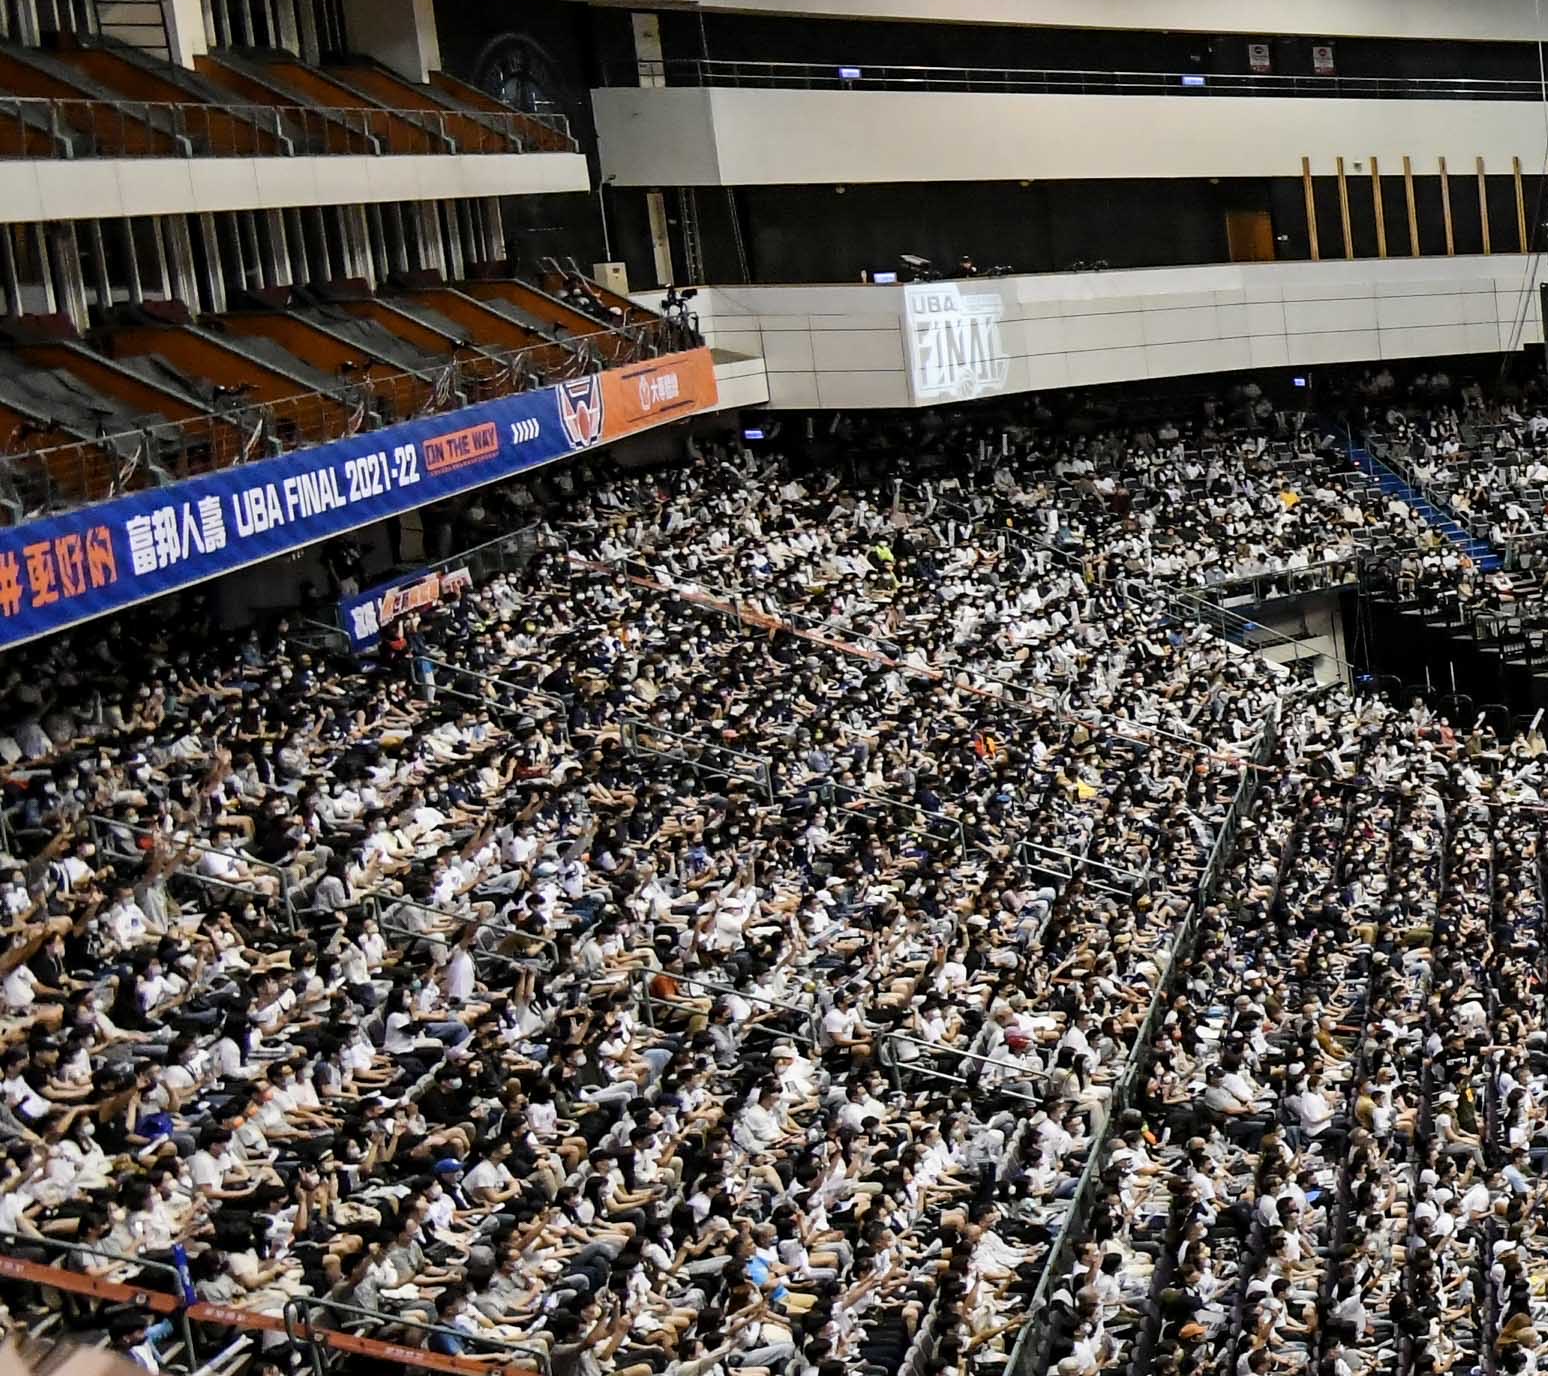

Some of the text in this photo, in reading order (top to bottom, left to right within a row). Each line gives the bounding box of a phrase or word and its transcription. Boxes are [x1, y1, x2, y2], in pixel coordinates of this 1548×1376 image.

[126, 495, 227, 576] 富邦人壽
[233, 482, 285, 539] UBA
[283, 466, 347, 521] FINAL
[344, 444, 420, 501] 2021-22
[447, 435, 470, 459] THE
[473, 429, 495, 454] WAY
